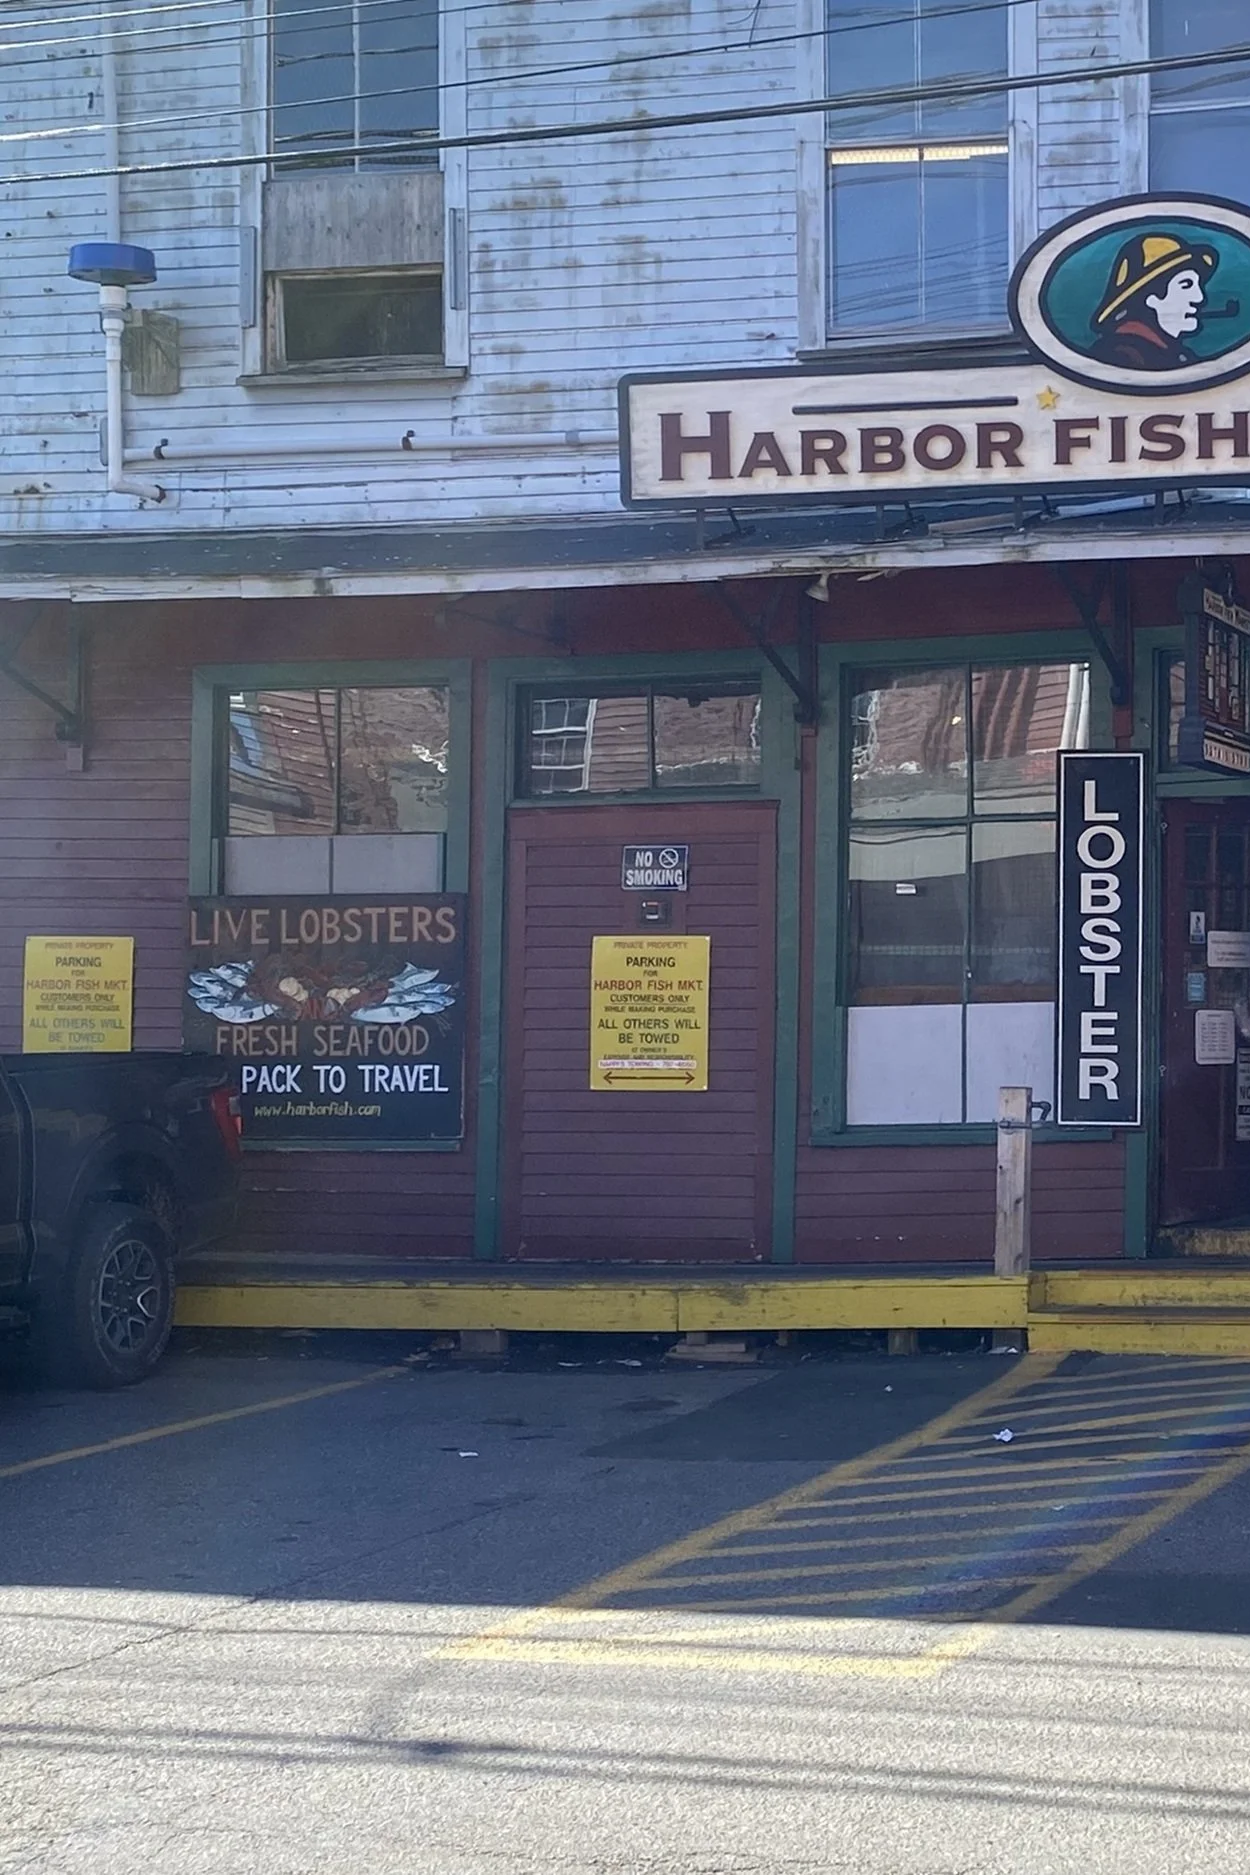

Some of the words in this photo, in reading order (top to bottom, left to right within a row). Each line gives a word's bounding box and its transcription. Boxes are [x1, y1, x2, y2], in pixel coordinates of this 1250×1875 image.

[658, 410, 1025, 481] HARBOR
[1053, 411, 1250, 465] FISH
[635, 851, 653, 867] NO
[626, 869, 683, 885] SMOKING
[190, 908, 270, 946] LIVE
[281, 906, 456, 945] LOBSTERS
[647, 941, 688, 949] PROPERTY
[1077, 779, 1126, 1100] LOBSTER
[55, 956, 102, 967] PARKING
[626, 957, 676, 968] PARKING
[27, 980, 71, 990] HARBOR
[76, 980, 100, 990] FISH
[594, 980, 642, 991] HARBOR
[647, 980, 673, 990] FISH
[40, 993, 91, 1001] CUSTOMERS
[94, 993, 115, 1001] ONLY
[610, 994, 665, 1003] CUSTOMERS
[668, 994, 690, 1003] ONLY
[29, 1018, 48, 1029] ALL
[53, 1018, 96, 1029] OTHERS
[101, 1018, 126, 1029] WILL
[598, 1018, 618, 1029] ALL
[623, 1018, 669, 1030] OTHERS
[675, 1018, 701, 1029] WILL
[49, 1033, 62, 1043] BE
[68, 1033, 105, 1044] TOWED
[216, 1025, 298, 1056] FRESH
[313, 1025, 430, 1057] SEAFOOD
[618, 1033, 633, 1044] BE
[640, 1033, 680, 1044] TOWED
[241, 1064, 302, 1094] PACK
[312, 1064, 346, 1094] TO
[358, 1064, 449, 1093] TRAVEL
[254, 1101, 381, 1117] www.harborfish.com
